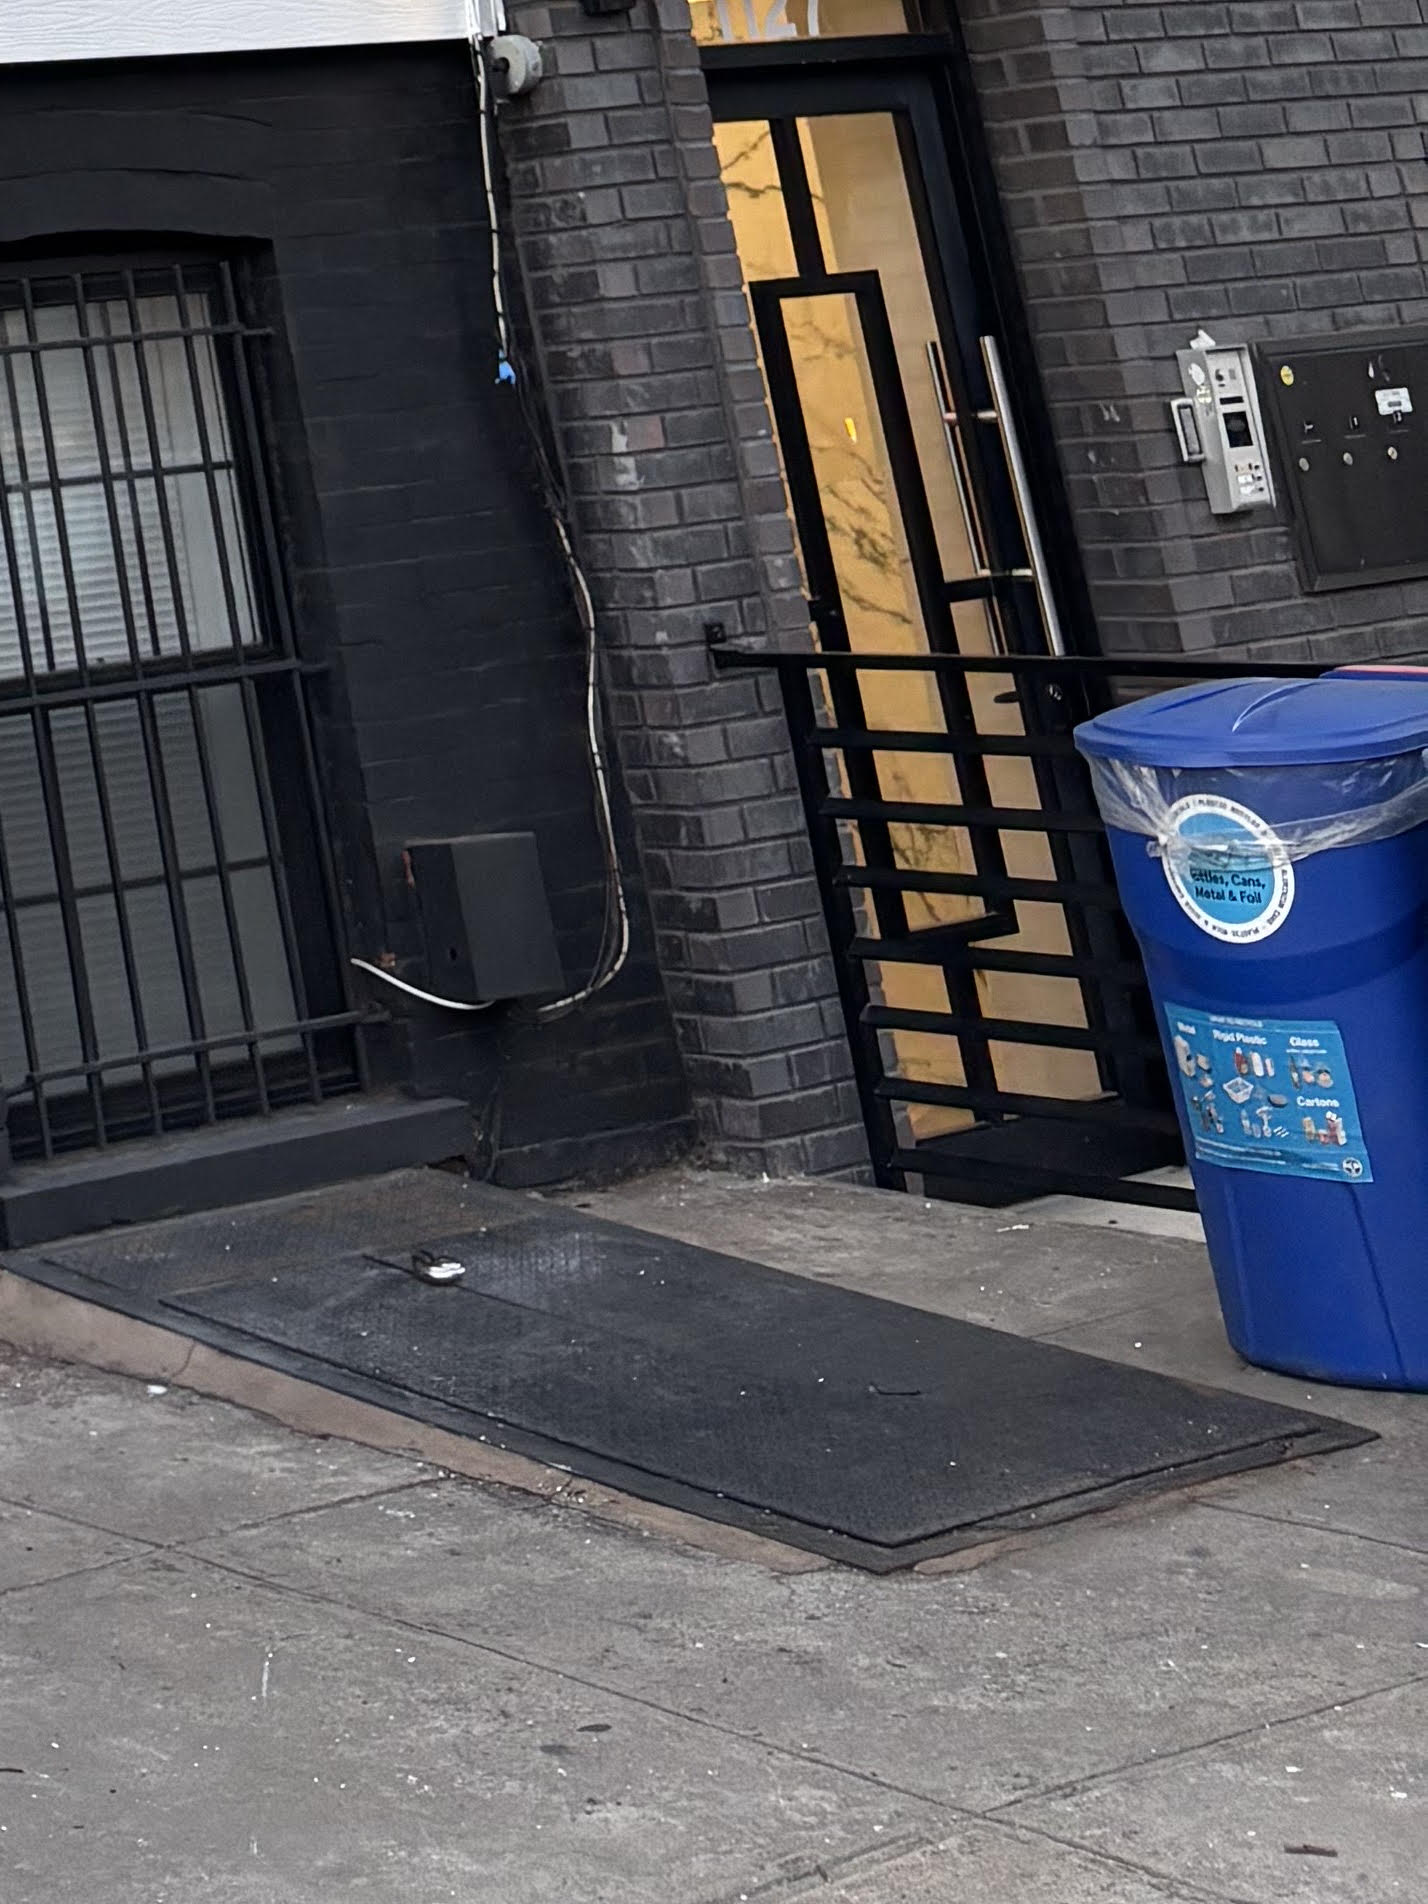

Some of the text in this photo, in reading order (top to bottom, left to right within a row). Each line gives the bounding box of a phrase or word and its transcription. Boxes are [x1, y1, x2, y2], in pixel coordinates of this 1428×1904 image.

[1231, 873, 1266, 890] Cans,
[1195, 885, 1226, 901] Metal
[1239, 890, 1263, 904] Foil
[1235, 1032, 1268, 1046] Plastic
[1289, 1035, 1320, 1047] Glass
[1296, 1095, 1340, 1109] Cartons
